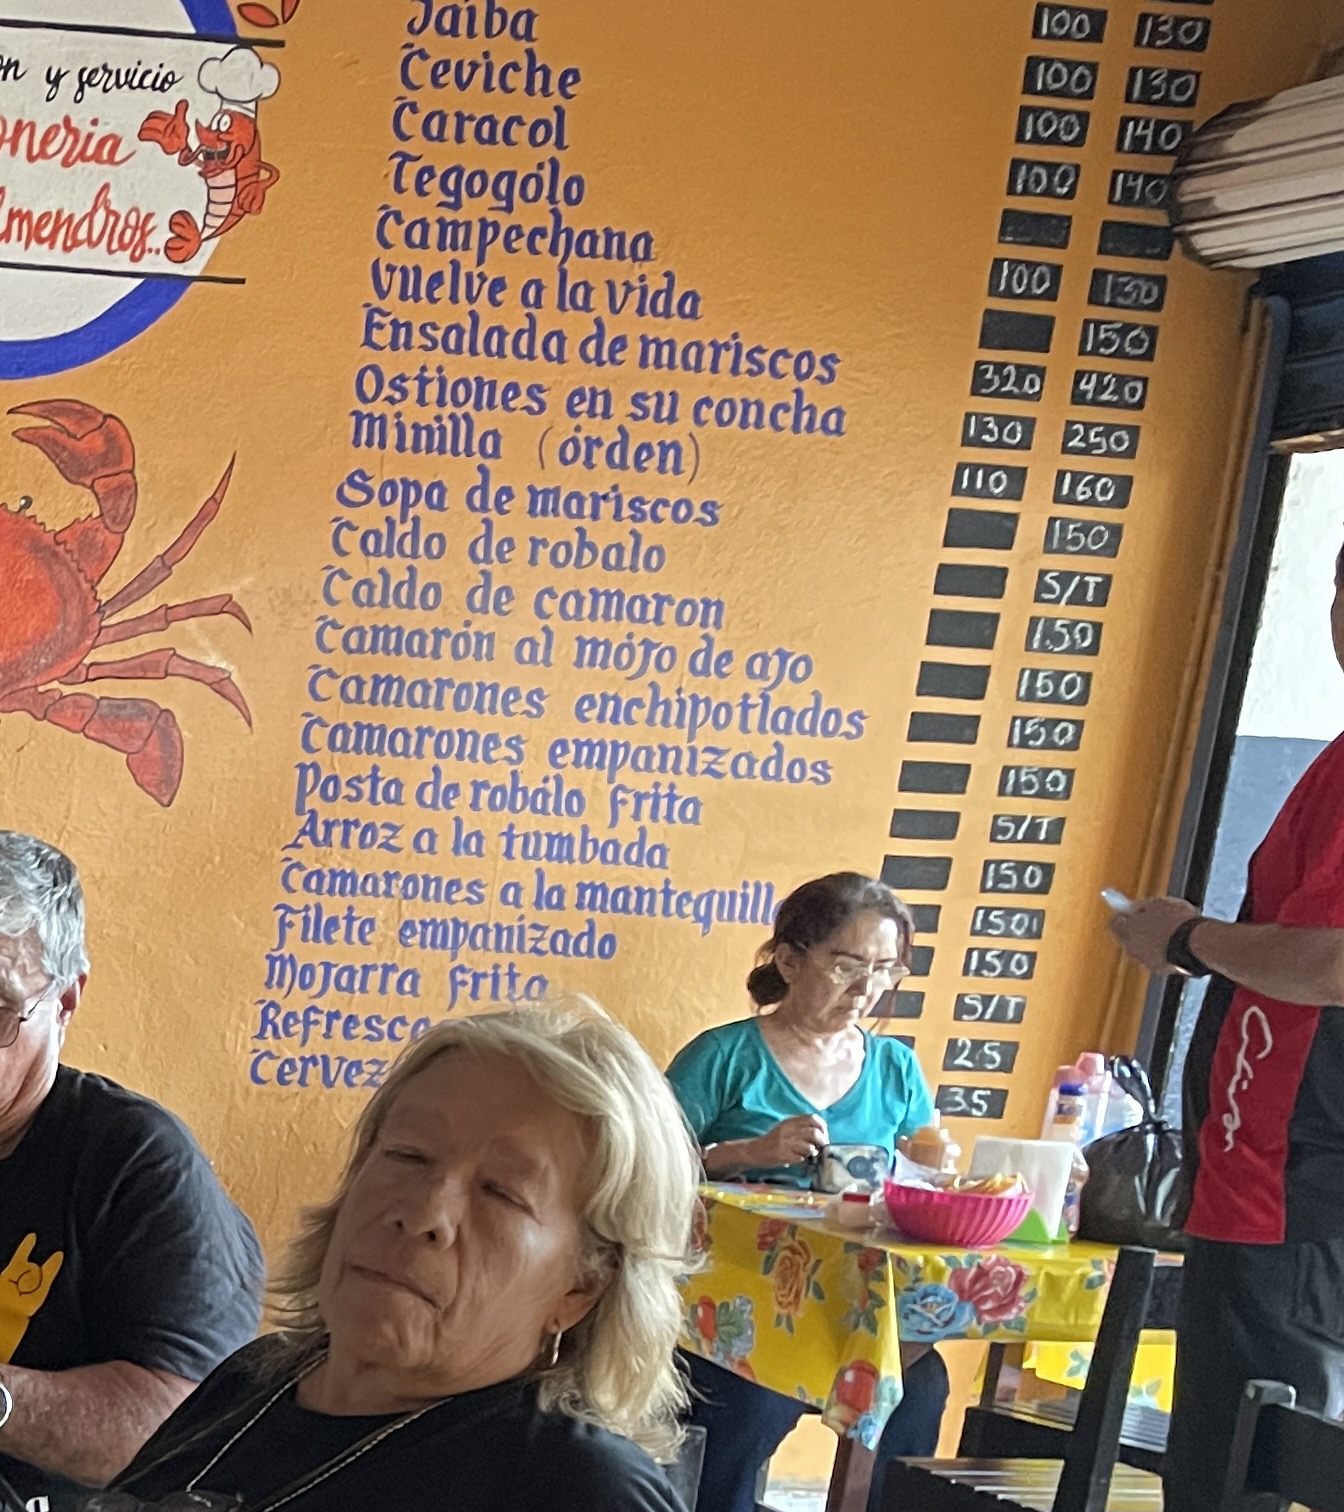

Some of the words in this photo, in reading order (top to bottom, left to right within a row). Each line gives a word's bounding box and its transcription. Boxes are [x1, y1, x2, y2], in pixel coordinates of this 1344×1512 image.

[408, 0, 536, 40] Jaiba
[1041, 7, 1091, 40] 100
[1142, 15, 1203, 46] 130
[45, 61, 71, 103] y
[75, 46, 184, 104] servicio
[401, 47, 580, 98] Ceviche
[1036, 61, 1092, 94] 100
[1133, 69, 1197, 103] 130
[393, 96, 569, 150] Caracol
[1025, 110, 1080, 142] 100
[1124, 118, 1182, 151] 140
[1016, 163, 1075, 195] 100
[1113, 172, 1167, 205] 140
[375, 204, 654, 265] Campechana
[522, 278, 544, 308] a
[558, 264, 593, 312] la
[608, 272, 701, 320] vida
[999, 260, 1051, 294] 100
[362, 303, 567, 364] Ensalada
[580, 318, 626, 366] de
[640, 334, 840, 384] mariscos
[1086, 321, 1150, 356] 150
[354, 365, 547, 416] Ostiones
[567, 386, 612, 418] en
[632, 390, 678, 424] su
[694, 389, 845, 436] concha
[979, 363, 1041, 395] 320
[1079, 373, 1144, 403] 420
[969, 415, 1022, 445] 130
[1067, 423, 1131, 455] 250
[337, 468, 447, 525] Sopa
[466, 464, 514, 514] de
[528, 486, 720, 526] mariscos
[962, 467, 1008, 497] 110
[1061, 471, 1115, 502] 160
[332, 515, 446, 560] Caldo
[470, 518, 514, 564] de
[530, 528, 665, 572] robalo
[1052, 519, 1109, 552] 150
[322, 566, 442, 610] Caldo
[468, 570, 514, 616] de
[534, 587, 724, 629] camaron
[1041, 571, 1104, 607] S/T
[515, 628, 553, 666] al
[690, 634, 733, 677] de
[308, 664, 550, 720] Camarones
[574, 682, 868, 741] enchipotlados
[1019, 670, 1082, 701] 150
[300, 711, 529, 766] Camarones
[547, 735, 834, 786] empanizados
[1012, 716, 1076, 748] 150
[295, 762, 403, 815] Posta
[416, 766, 460, 809] de
[1005, 766, 1067, 796] 150
[286, 809, 402, 852] Arroz
[413, 829, 438, 854] a
[453, 818, 484, 857] la
[501, 823, 668, 868] tumbada
[996, 814, 1057, 841] S/T
[985, 863, 1043, 890] 150
[280, 860, 484, 907] Camarones
[500, 882, 522, 907] a
[534, 870, 566, 911] la
[576, 879, 782, 936] mantequill
[274, 904, 376, 950] Filete
[399, 916, 617, 960] empanizado
[968, 950, 1030, 978] 150
[962, 993, 1024, 1024] S/T
[250, 1050, 386, 1088] Cervez
[953, 1041, 1002, 1070] 25
[942, 1088, 991, 1116] 35
